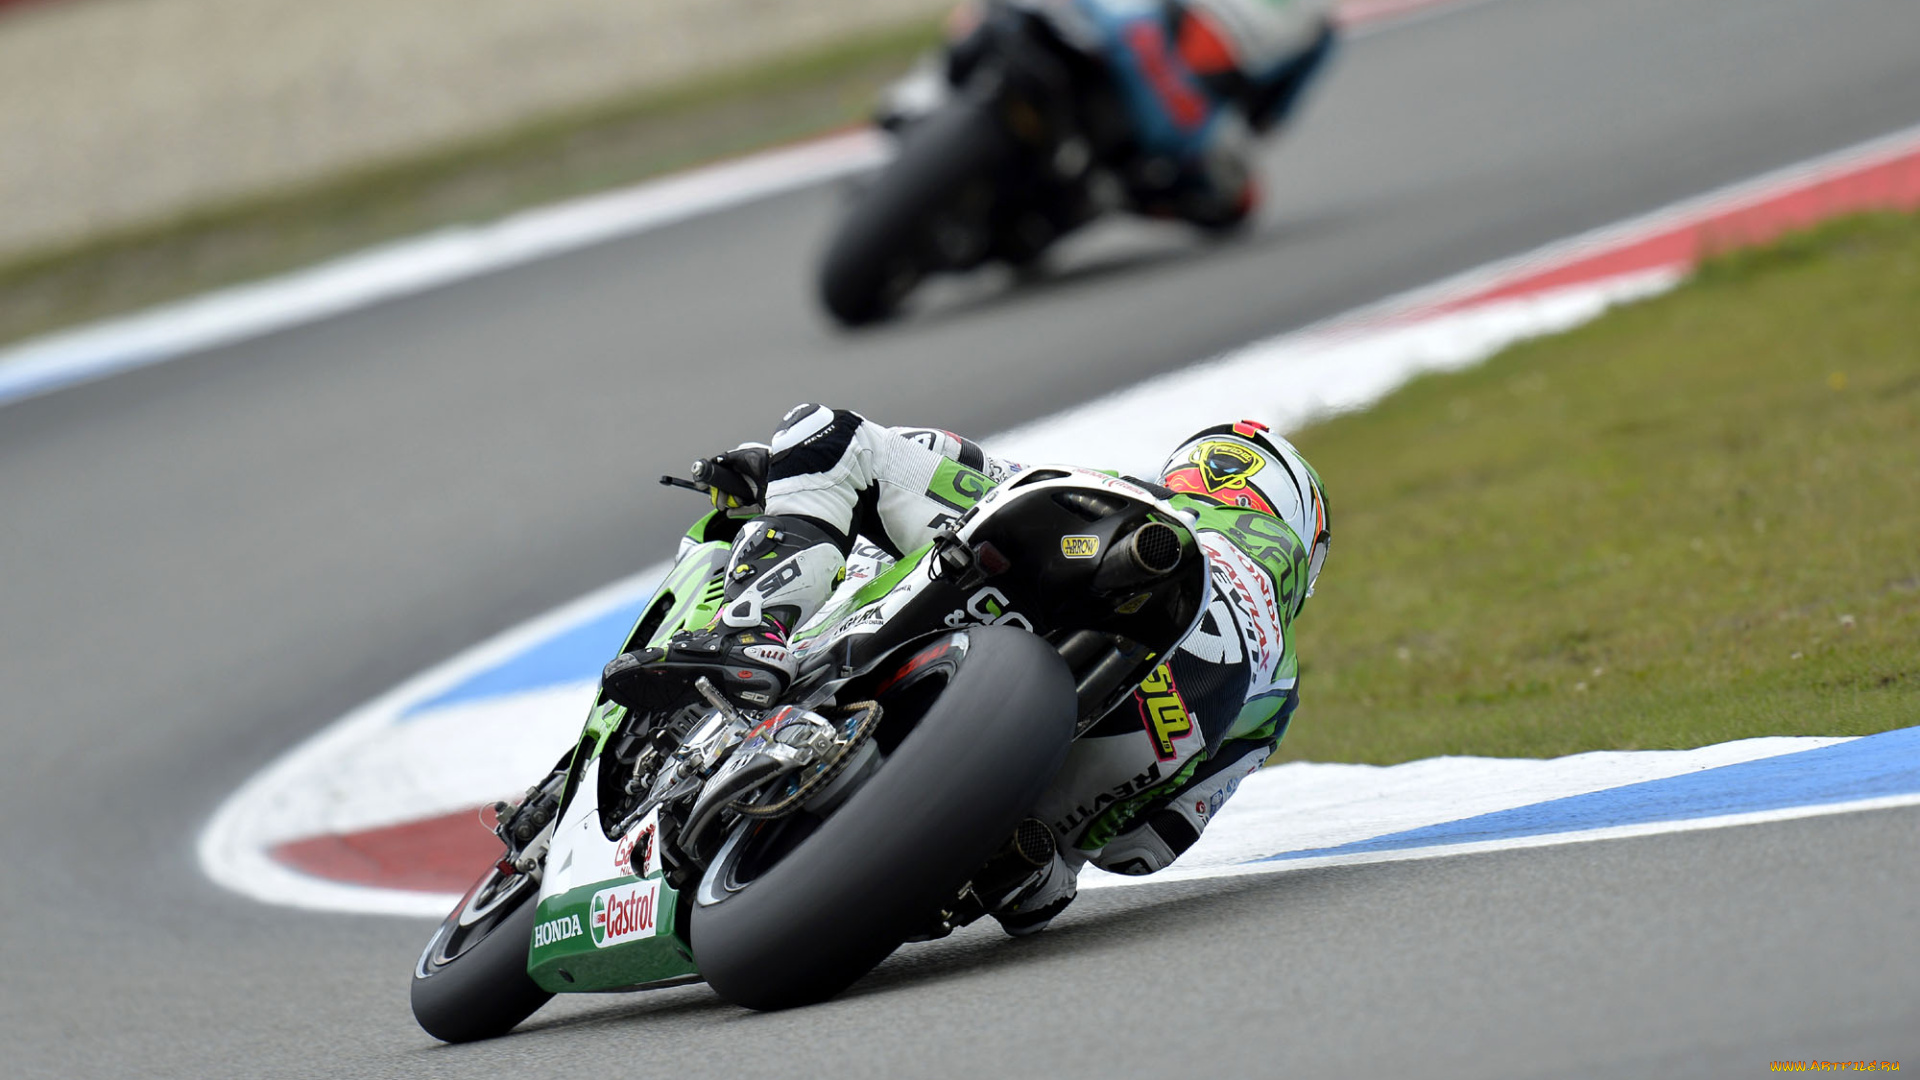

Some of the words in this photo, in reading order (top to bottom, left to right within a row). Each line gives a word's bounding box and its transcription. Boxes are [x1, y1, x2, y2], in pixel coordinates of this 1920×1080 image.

[1065, 540, 1097, 554] ARROW
[756, 558, 802, 599] SIDI
[741, 691, 769, 704] SIDI
[534, 914, 583, 948] HONDA
[607, 886, 655, 938] Castrol
